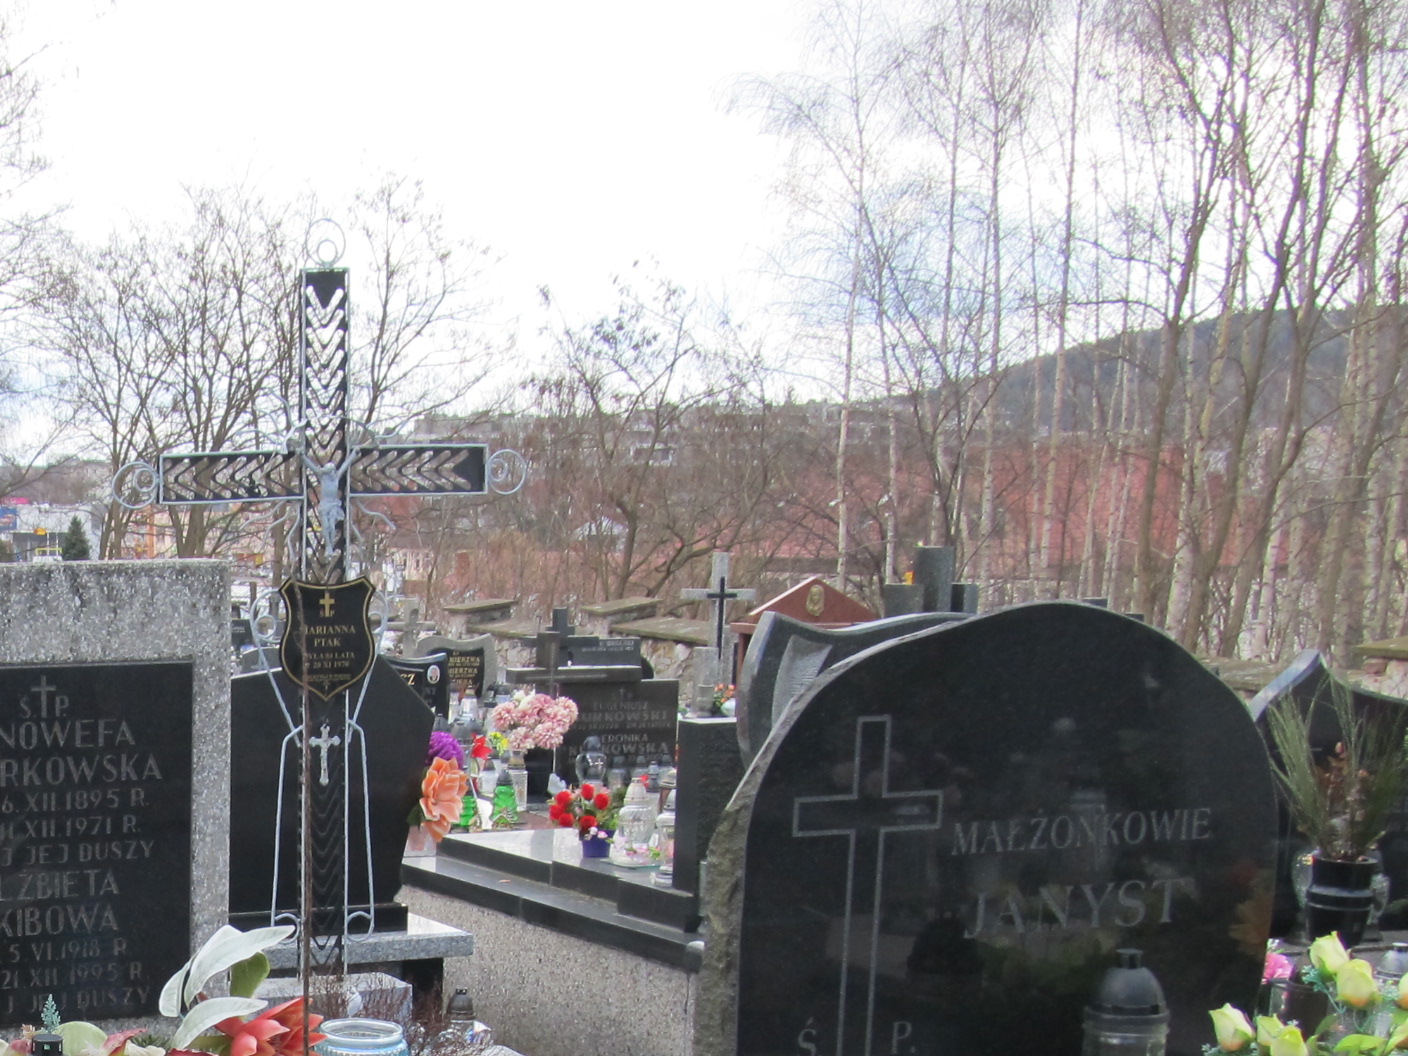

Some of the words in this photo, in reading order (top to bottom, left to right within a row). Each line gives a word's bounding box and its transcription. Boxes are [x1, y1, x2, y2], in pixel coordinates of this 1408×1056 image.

[314, 637, 341, 647] PTAK
[54, 695, 70, 718] P.
[600, 733, 649, 744] ERONIKA
[130, 787, 150, 808] R.
[122, 814, 142, 835] R.
[950, 807, 1213, 856] MAŁŻONKOWIE
[28, 843, 70, 867] JEJ
[79, 839, 156, 863] DUSZY
[963, 877, 1194, 939] JANYST
[76, 985, 152, 1012] DUSZY
[891, 1020, 916, 1055] P.
